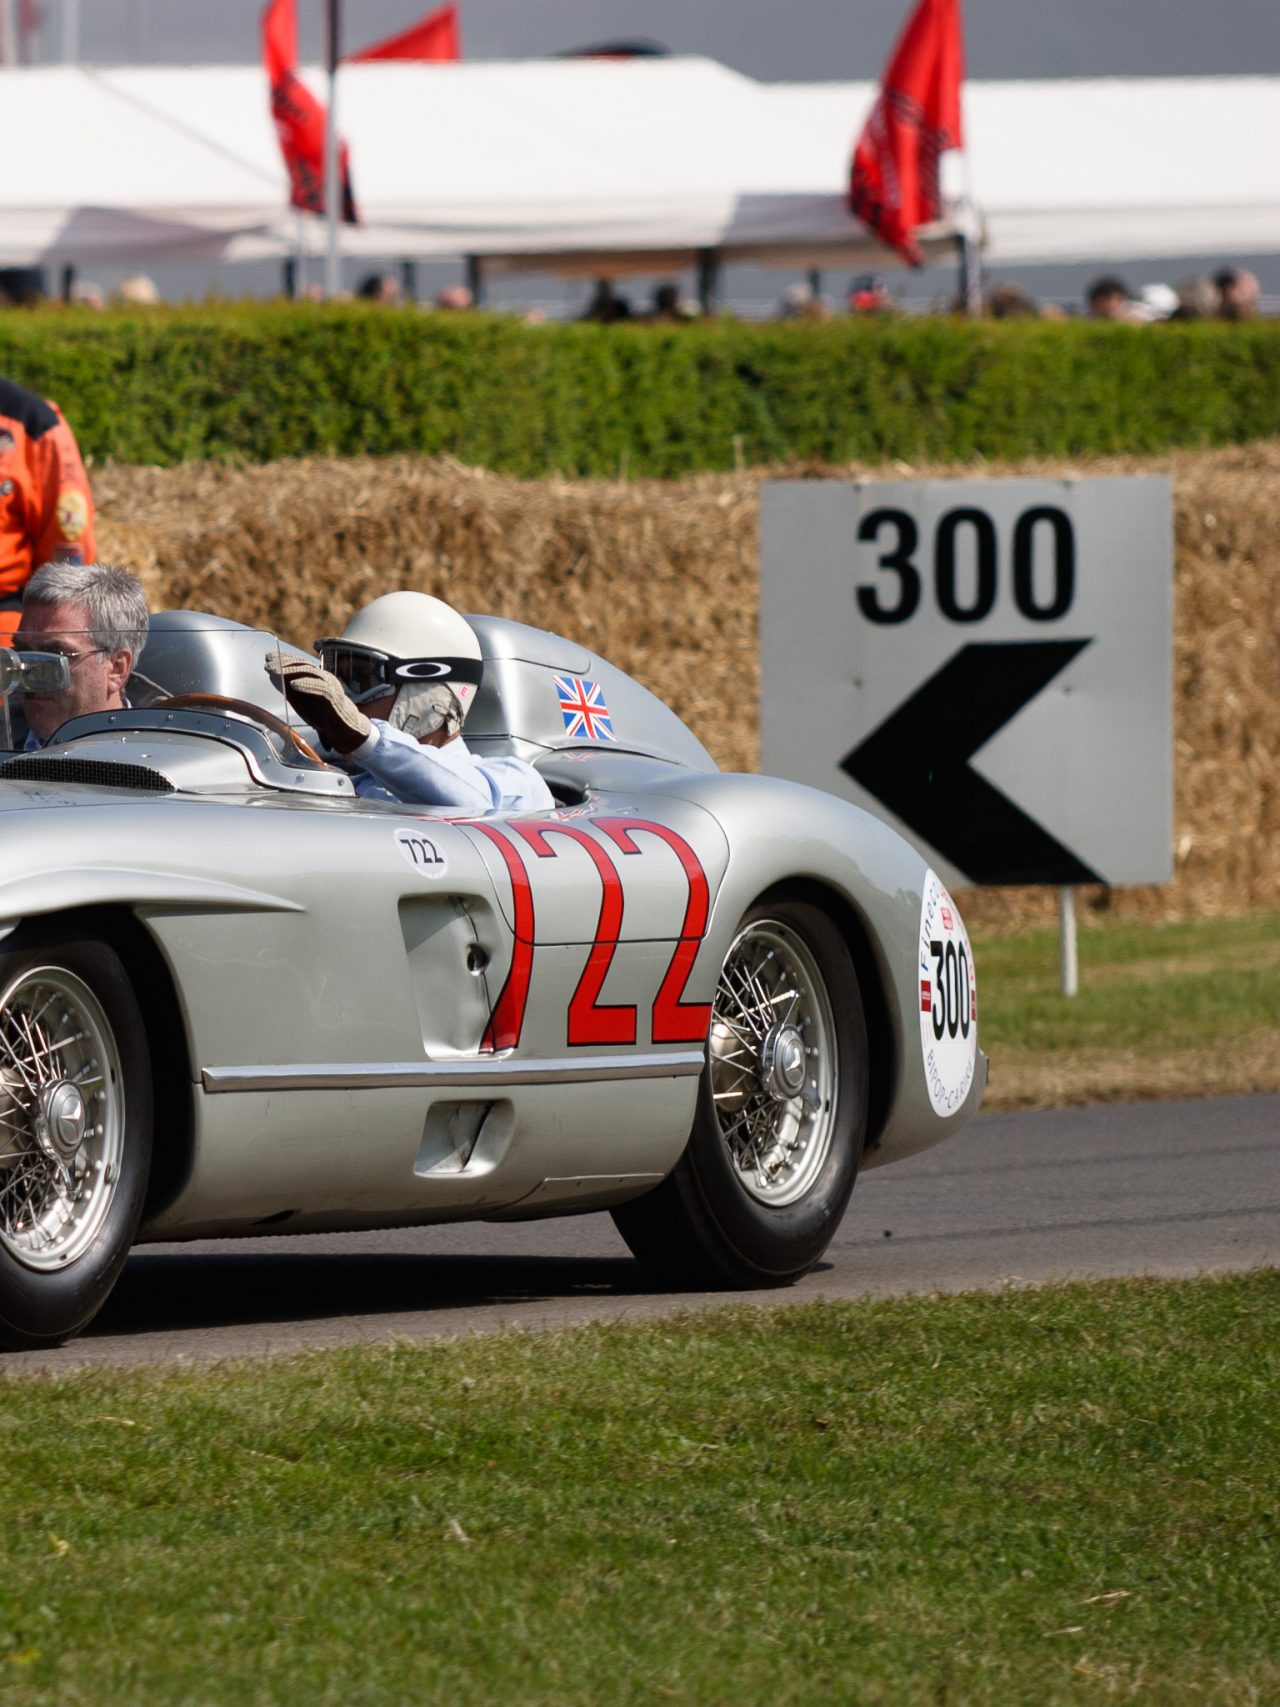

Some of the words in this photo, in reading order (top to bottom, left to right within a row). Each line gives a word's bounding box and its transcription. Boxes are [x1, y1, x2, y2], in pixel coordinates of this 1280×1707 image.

[856, 506, 1076, 625] 300
[399, 838, 444, 864] 722
[430, 816, 713, 1055] 722
[930, 940, 970, 1040] 300
